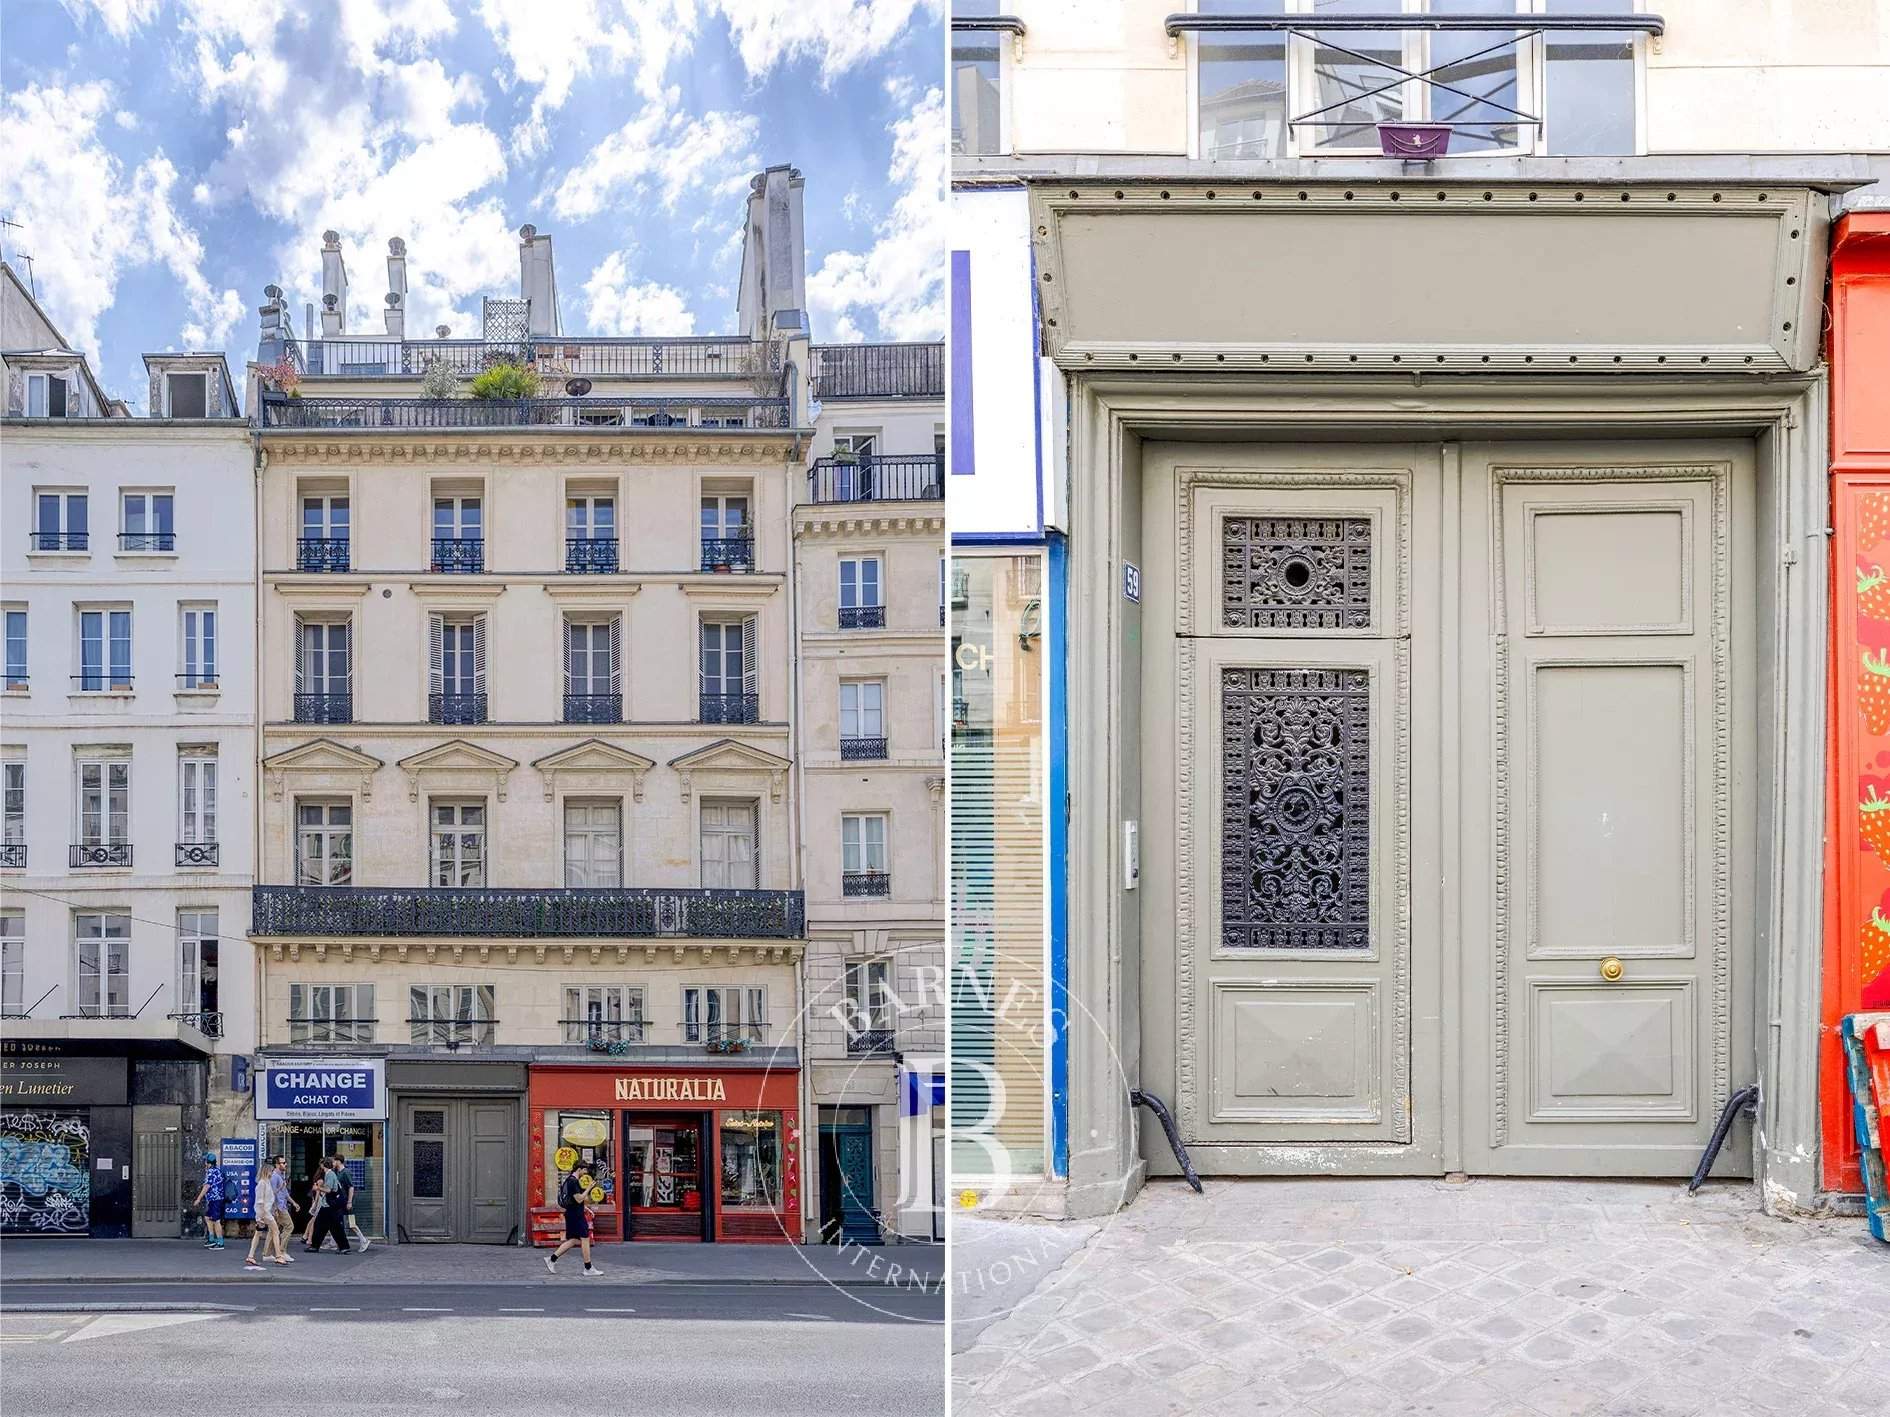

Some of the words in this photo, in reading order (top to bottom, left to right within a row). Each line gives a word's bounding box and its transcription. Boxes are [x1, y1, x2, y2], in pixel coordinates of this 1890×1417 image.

[1128, 566, 1139, 597] 59
[17, 1080, 75, 1095] Lunetier
[274, 1072, 367, 1089] CHANGE
[615, 1078, 727, 1101] NATURALIA
[293, 1095, 330, 1105] ACHAT
[332, 1095, 349, 1105] OR
[270, 1125, 299, 1134] CHANGE
[303, 1126, 324, 1135] ACHAT
[326, 1126, 336, 1135] OR
[340, 1127, 366, 1136] CHANGE
